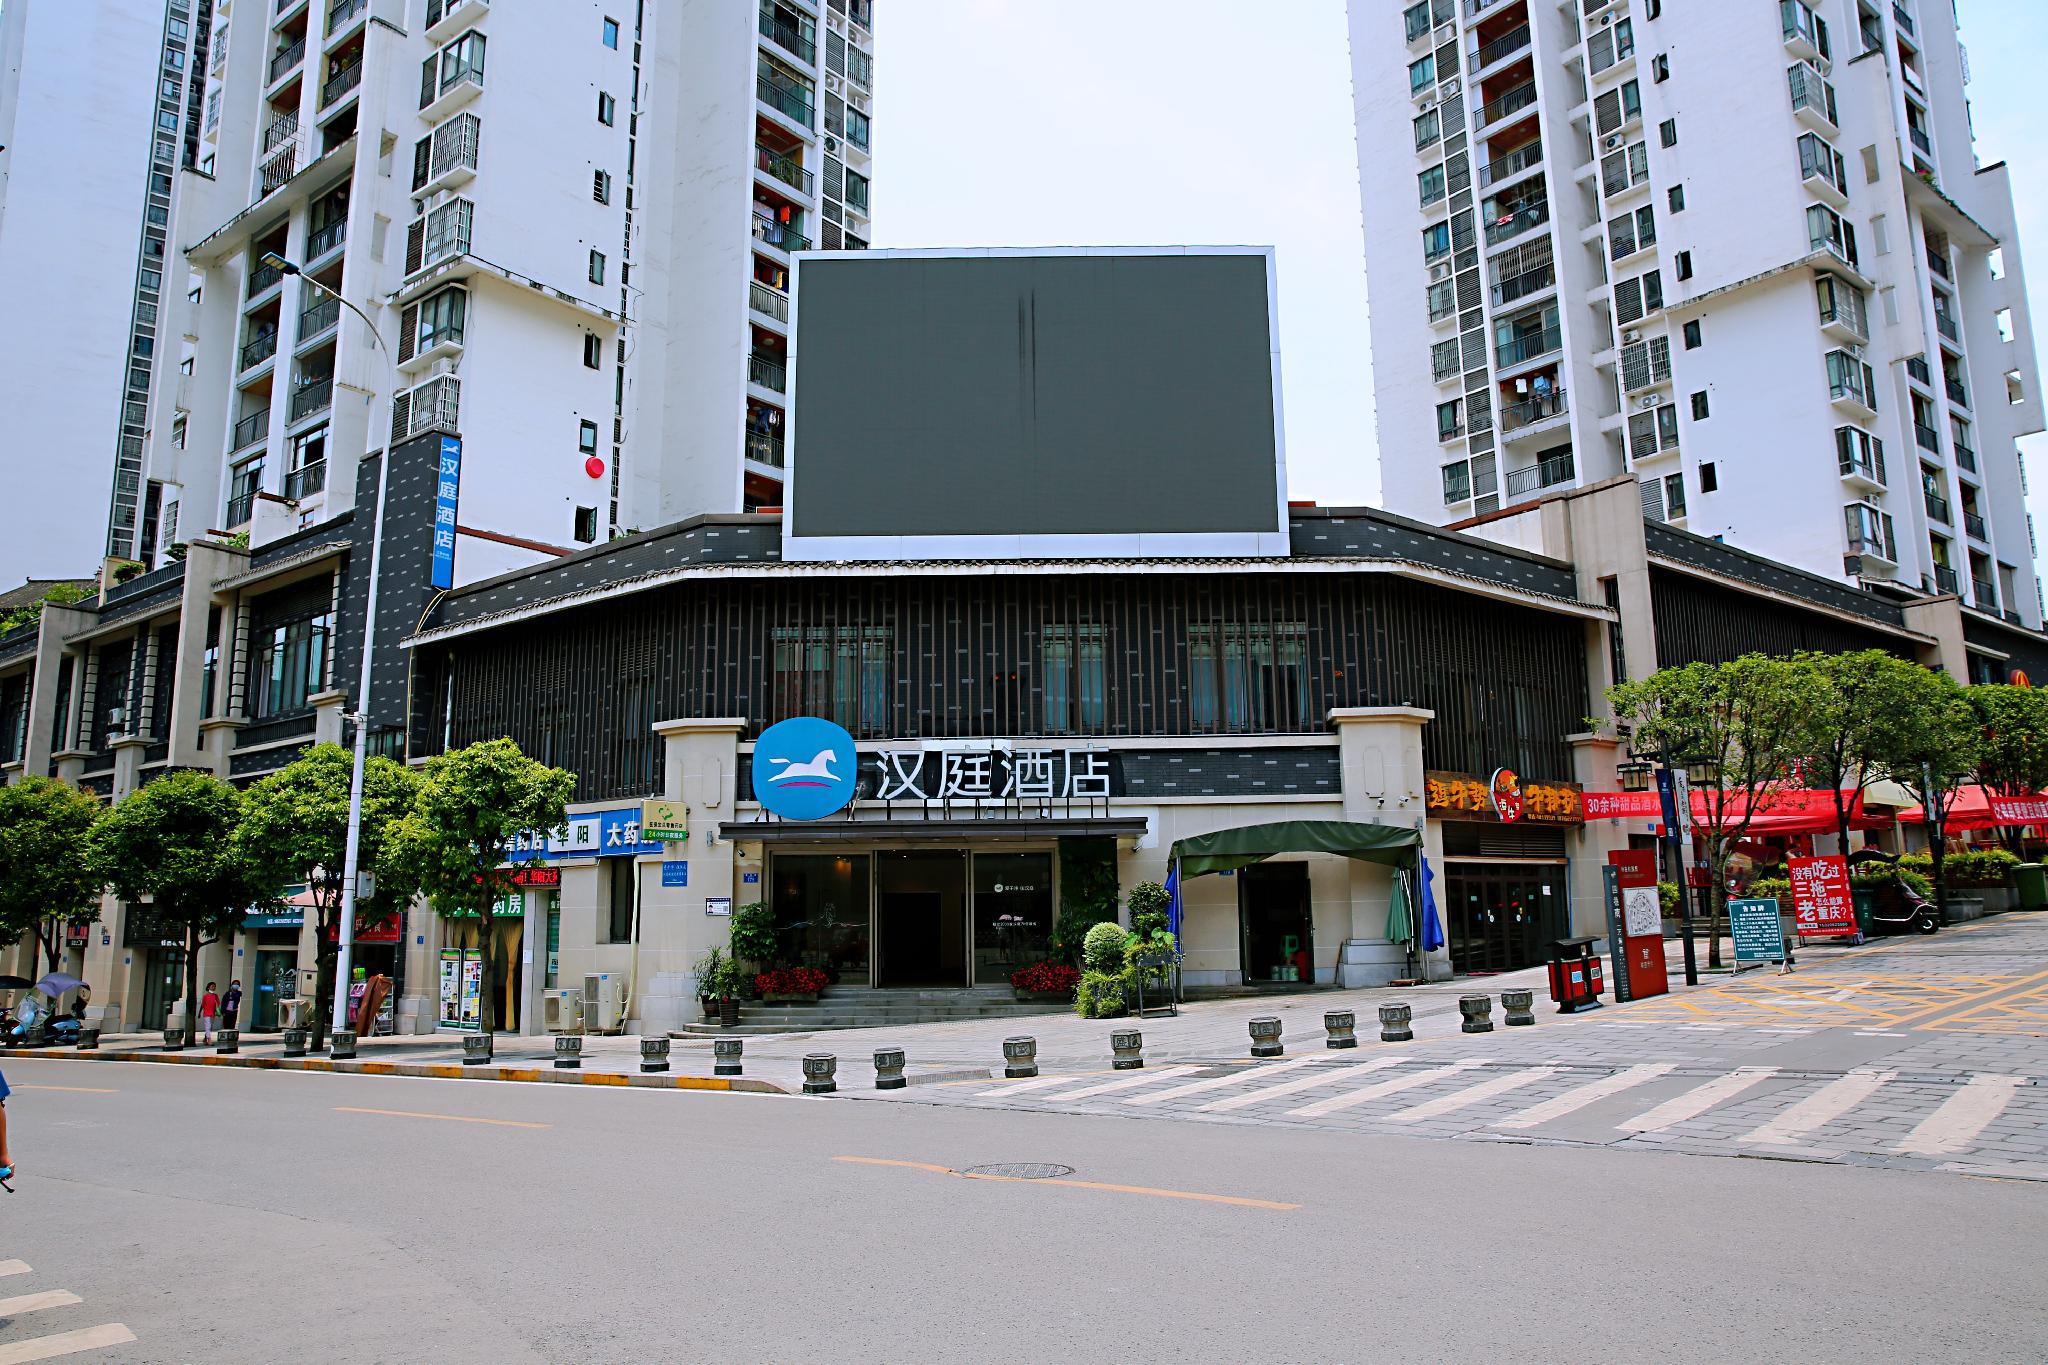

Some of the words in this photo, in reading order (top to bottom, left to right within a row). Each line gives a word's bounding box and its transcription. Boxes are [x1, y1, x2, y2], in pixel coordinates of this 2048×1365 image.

[435, 457, 458, 550] 汉庭酒店
[876, 743, 1110, 800] 汉庭酒店
[606, 821, 656, 848] 大药
[1792, 860, 1840, 880] 没有吃过
[1795, 880, 1841, 898] 三拖一
